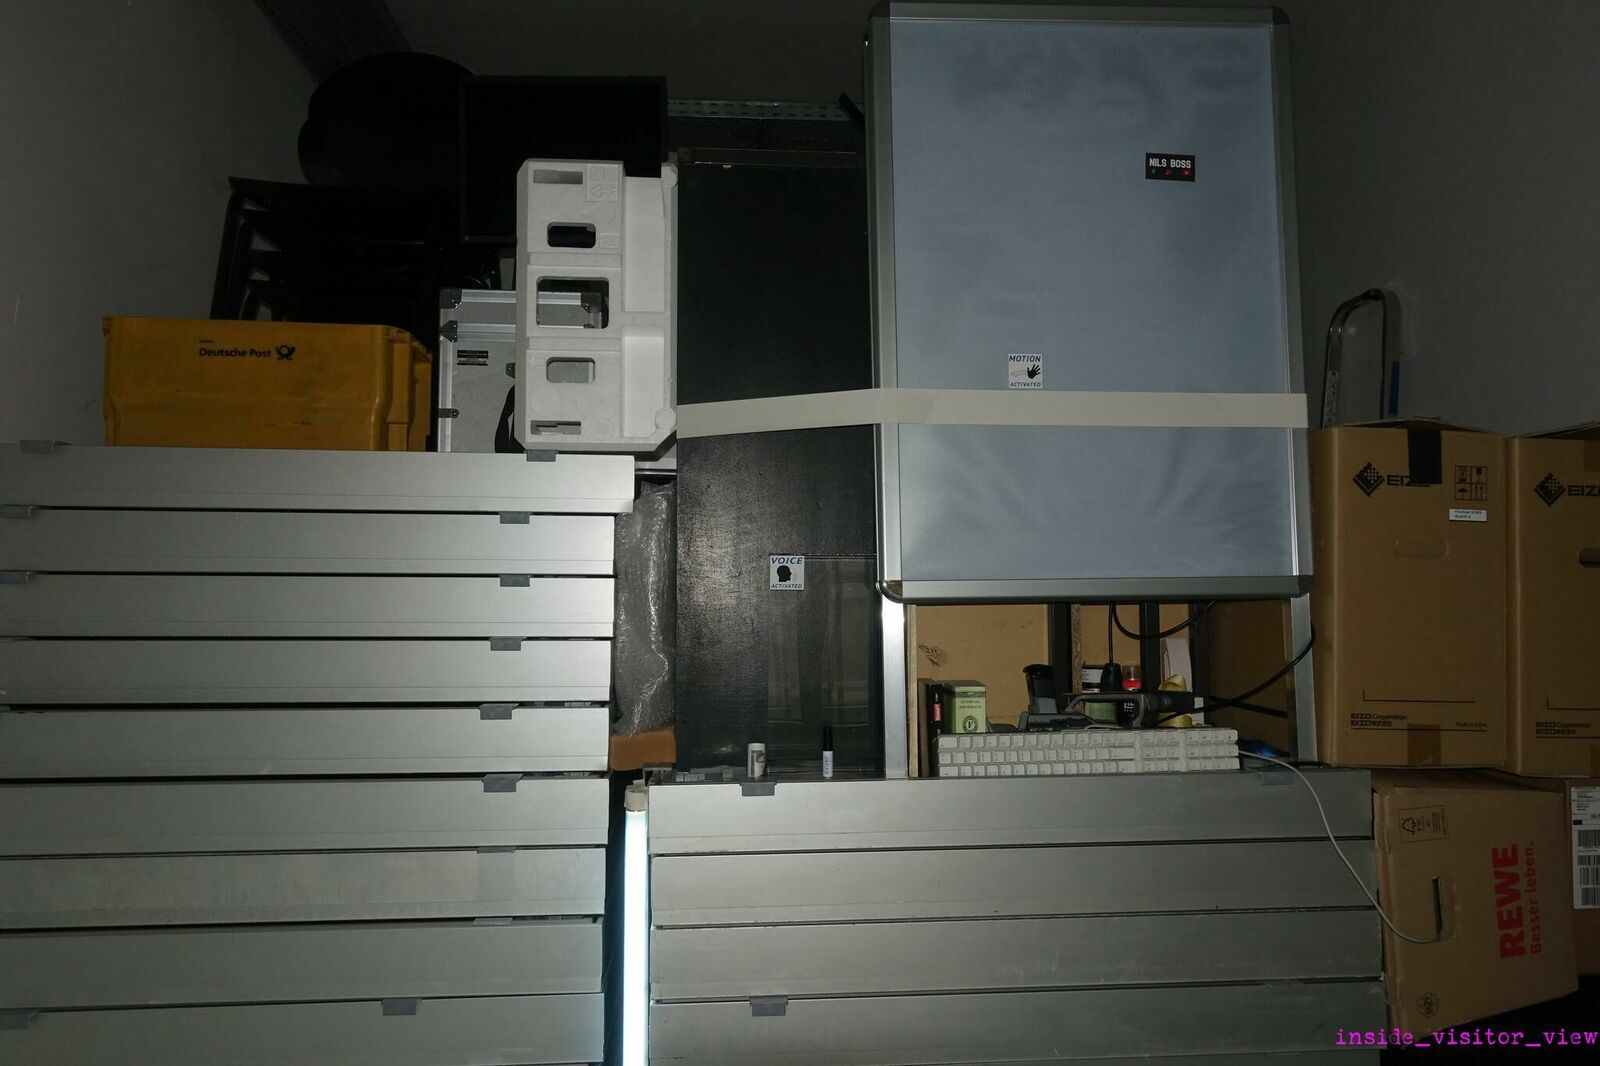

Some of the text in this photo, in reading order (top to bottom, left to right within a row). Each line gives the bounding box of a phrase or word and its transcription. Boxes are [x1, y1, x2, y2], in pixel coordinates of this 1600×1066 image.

[1149, 157, 1192, 169] NILS BOSS
[199, 347, 272, 358] Deutsche Post
[1387, 474, 1431, 488] EIZ
[1567, 484, 1600, 497] EIZ
[771, 556, 803, 565] VOICE
[1492, 843, 1526, 959] REWE
[1524, 840, 1542, 954] Besser leben.
